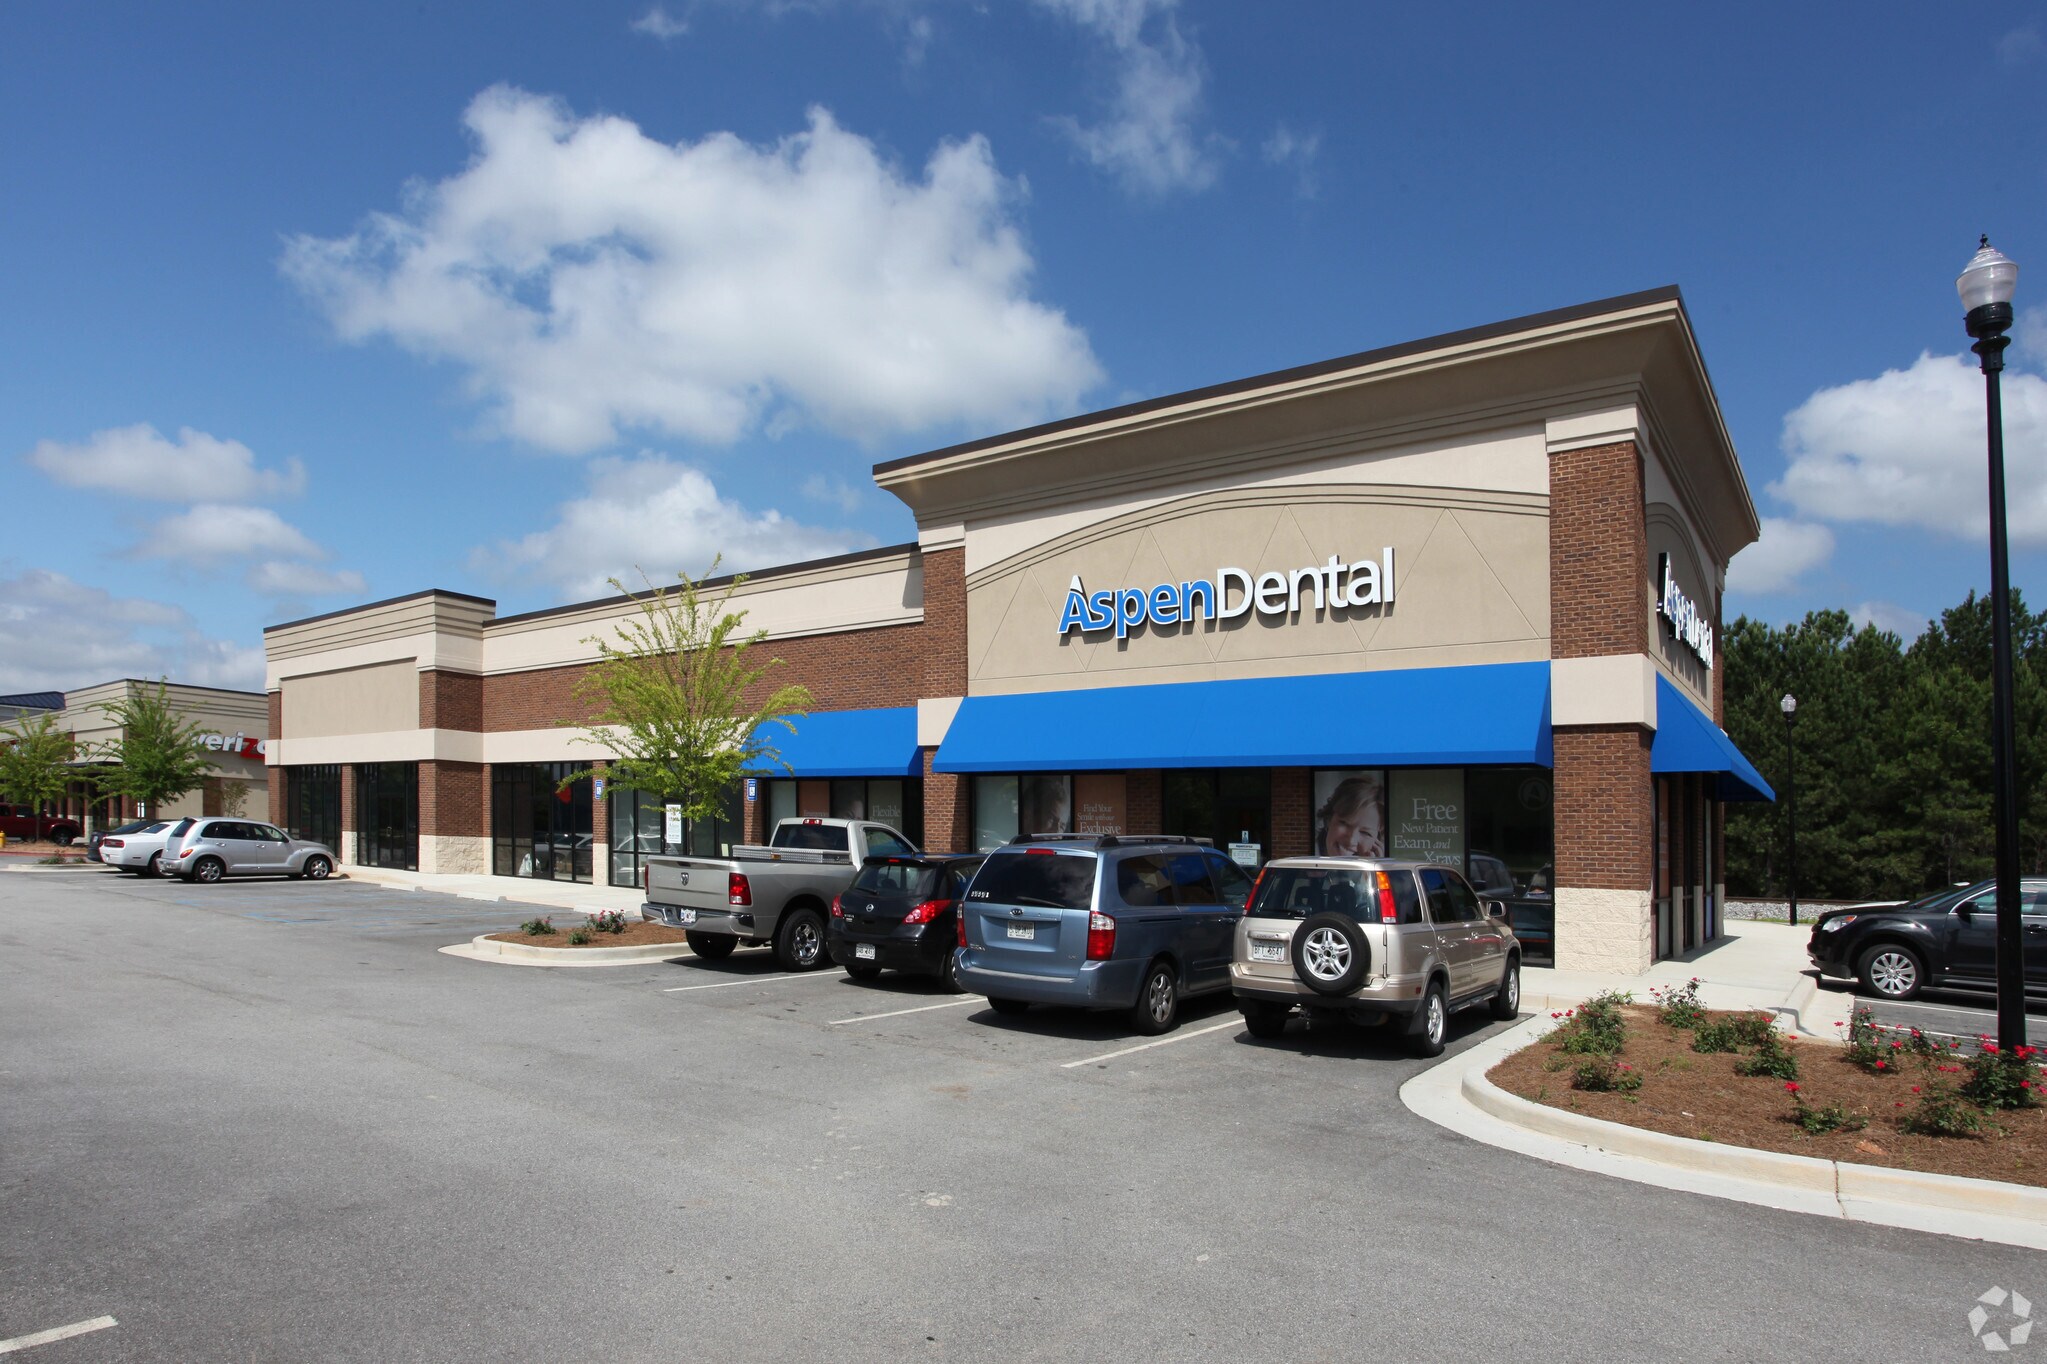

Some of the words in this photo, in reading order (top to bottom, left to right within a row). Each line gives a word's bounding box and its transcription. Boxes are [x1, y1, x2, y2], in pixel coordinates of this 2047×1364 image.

[1057, 547, 1395, 639] AspenDental
[872, 805, 901, 817] Flexible
[1083, 803, 1098, 812] Find
[1098, 803, 1113, 812] Your
[1412, 798, 1458, 820] Free
[1077, 812, 1094, 821] Smile
[1080, 821, 1122, 835] Exclusive
[1401, 823, 1425, 833] New
[1425, 823, 1459, 834] Patient
[1394, 835, 1431, 849] Exam
[1432, 838, 1451, 849] and
[1424, 850, 1461, 865] X-rays
